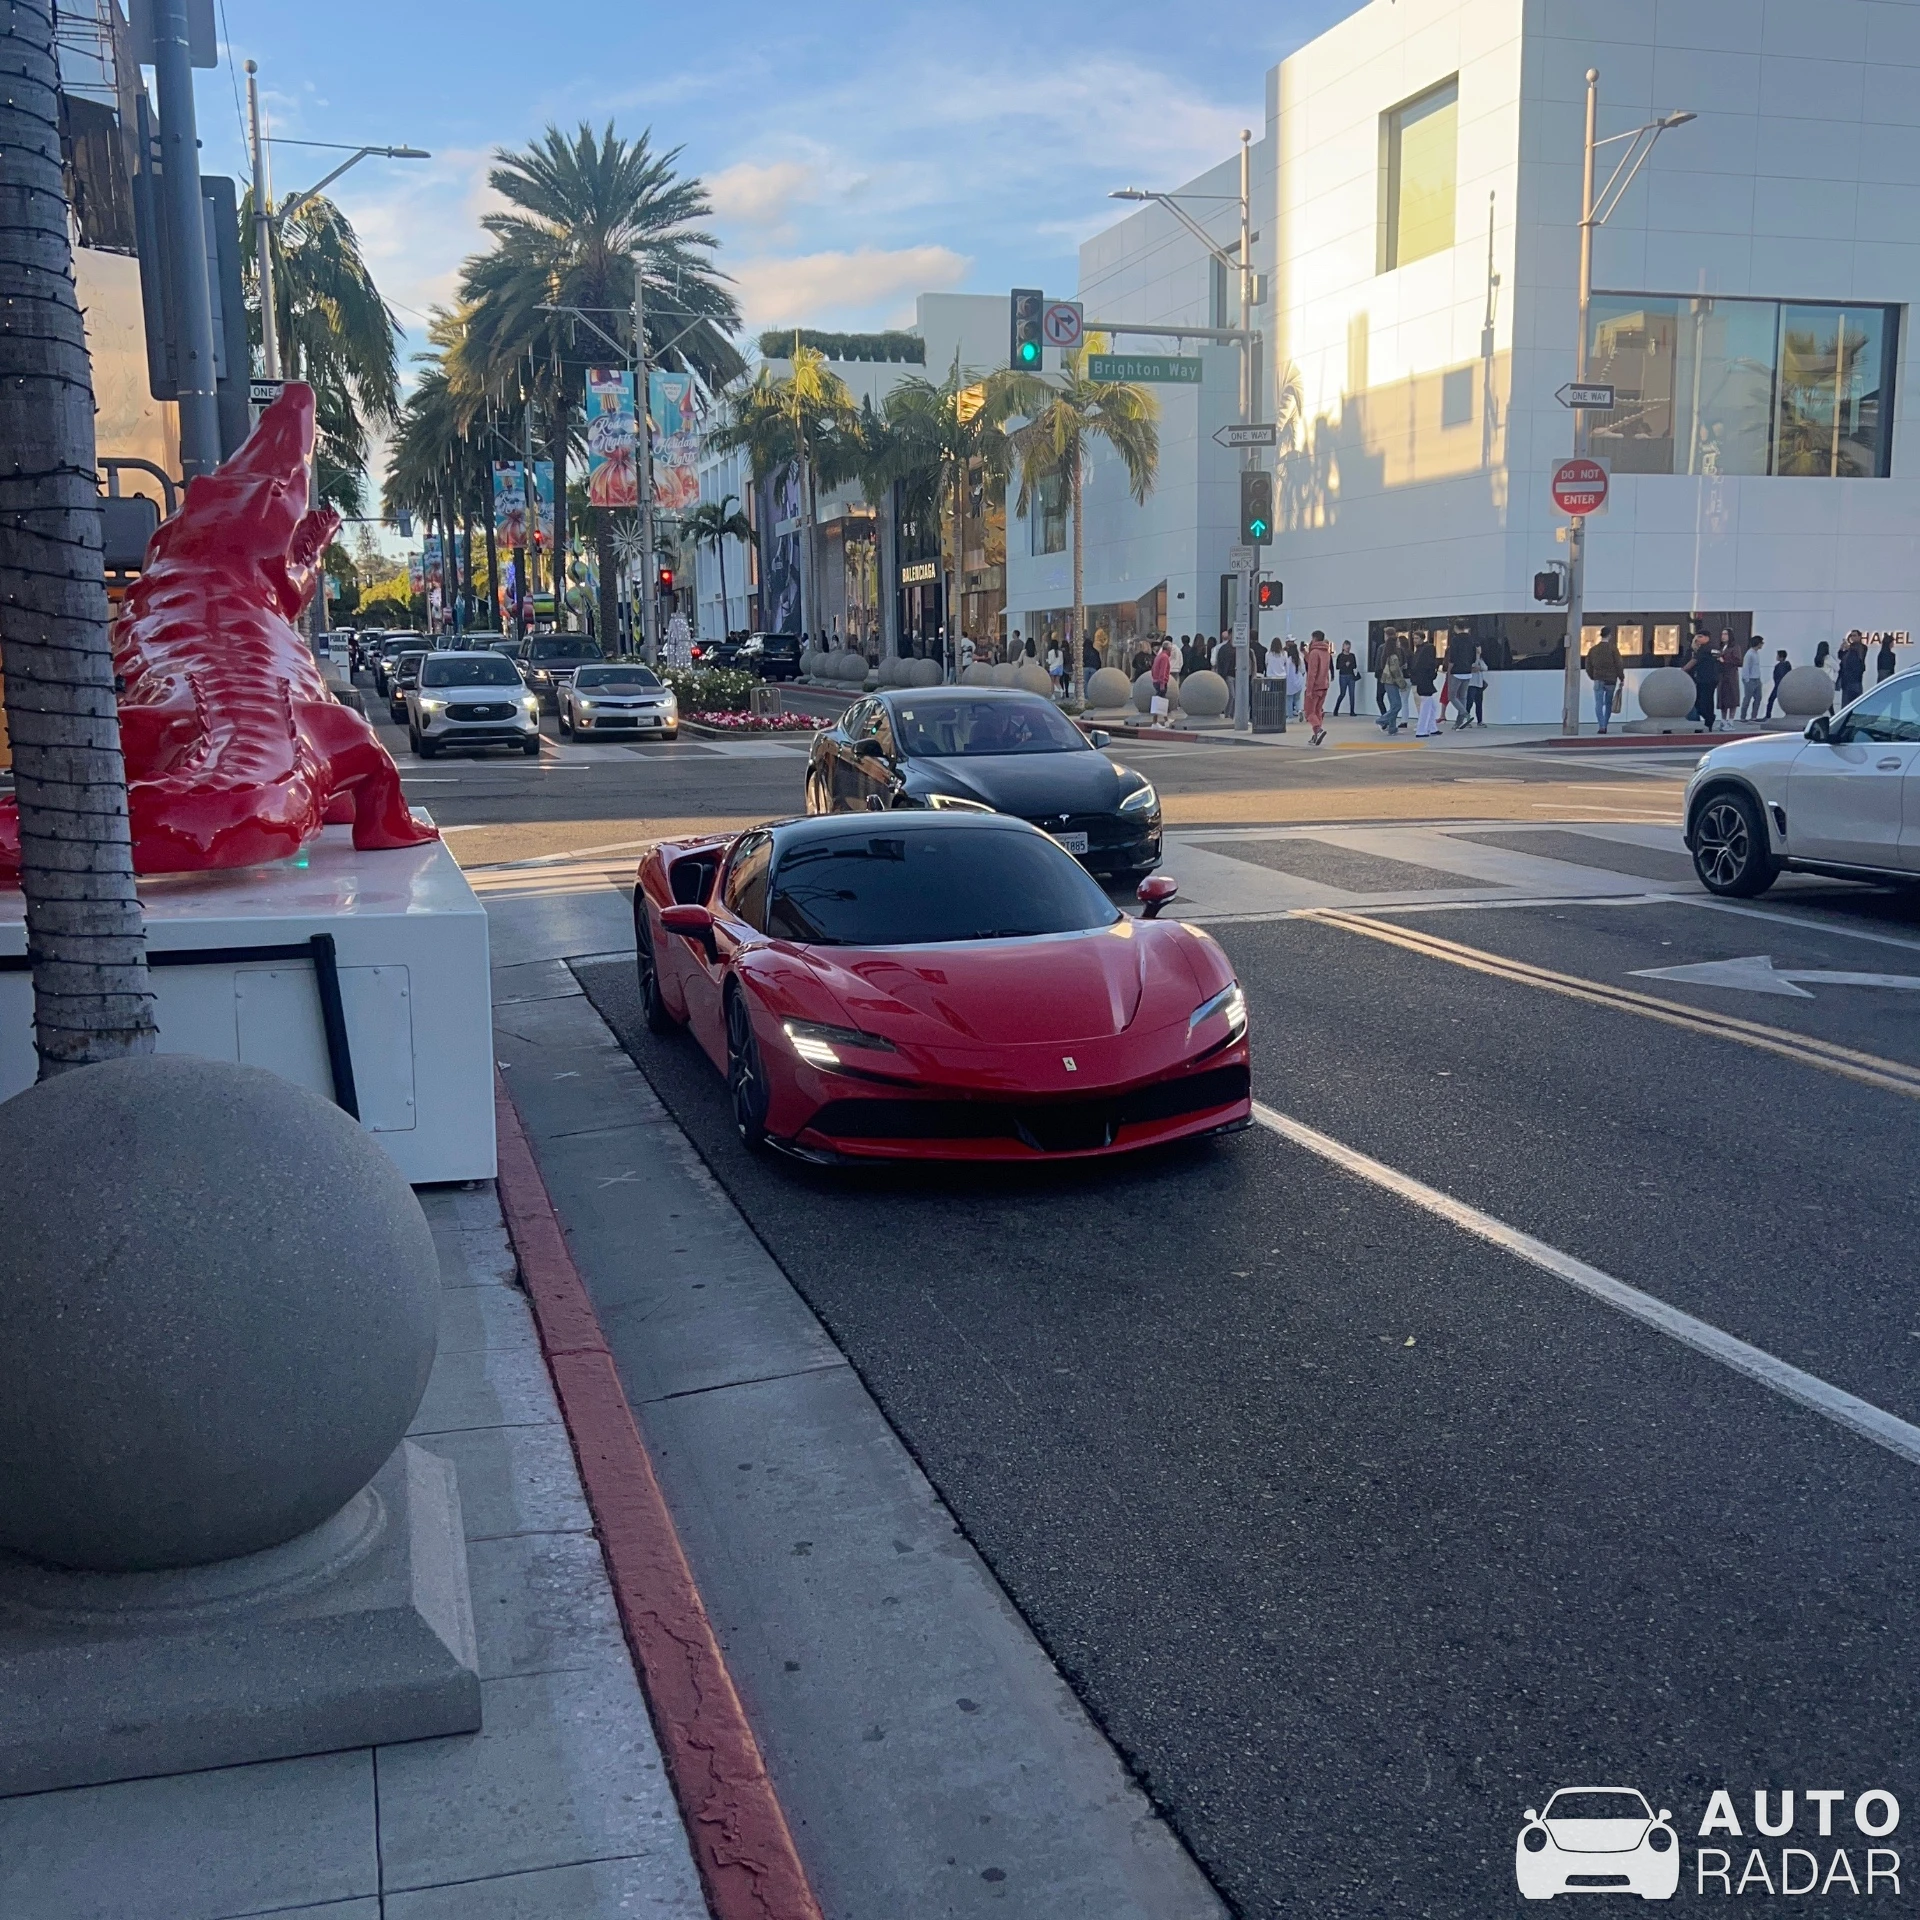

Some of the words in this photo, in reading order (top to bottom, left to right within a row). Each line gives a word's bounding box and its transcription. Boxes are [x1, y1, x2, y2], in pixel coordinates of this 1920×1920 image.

[1094, 361, 1161, 379] Brighton
[1169, 362, 1199, 380] Way
[253, 387, 274, 397] ONE
[1572, 391, 1589, 402] ONE
[1590, 390, 1608, 401] WAY
[594, 417, 634, 436] Rodeo
[1231, 431, 1249, 441] ONE
[1250, 430, 1269, 440] WAY
[592, 433, 632, 453] Nights
[661, 451, 697, 467] Lights
[1561, 470, 1576, 480] DO
[1580, 469, 1600, 479] NOT
[1563, 494, 1595, 505] ENTER
[1231, 560, 1241, 568] OK
[902, 562, 936, 584] BALENCIAGA
